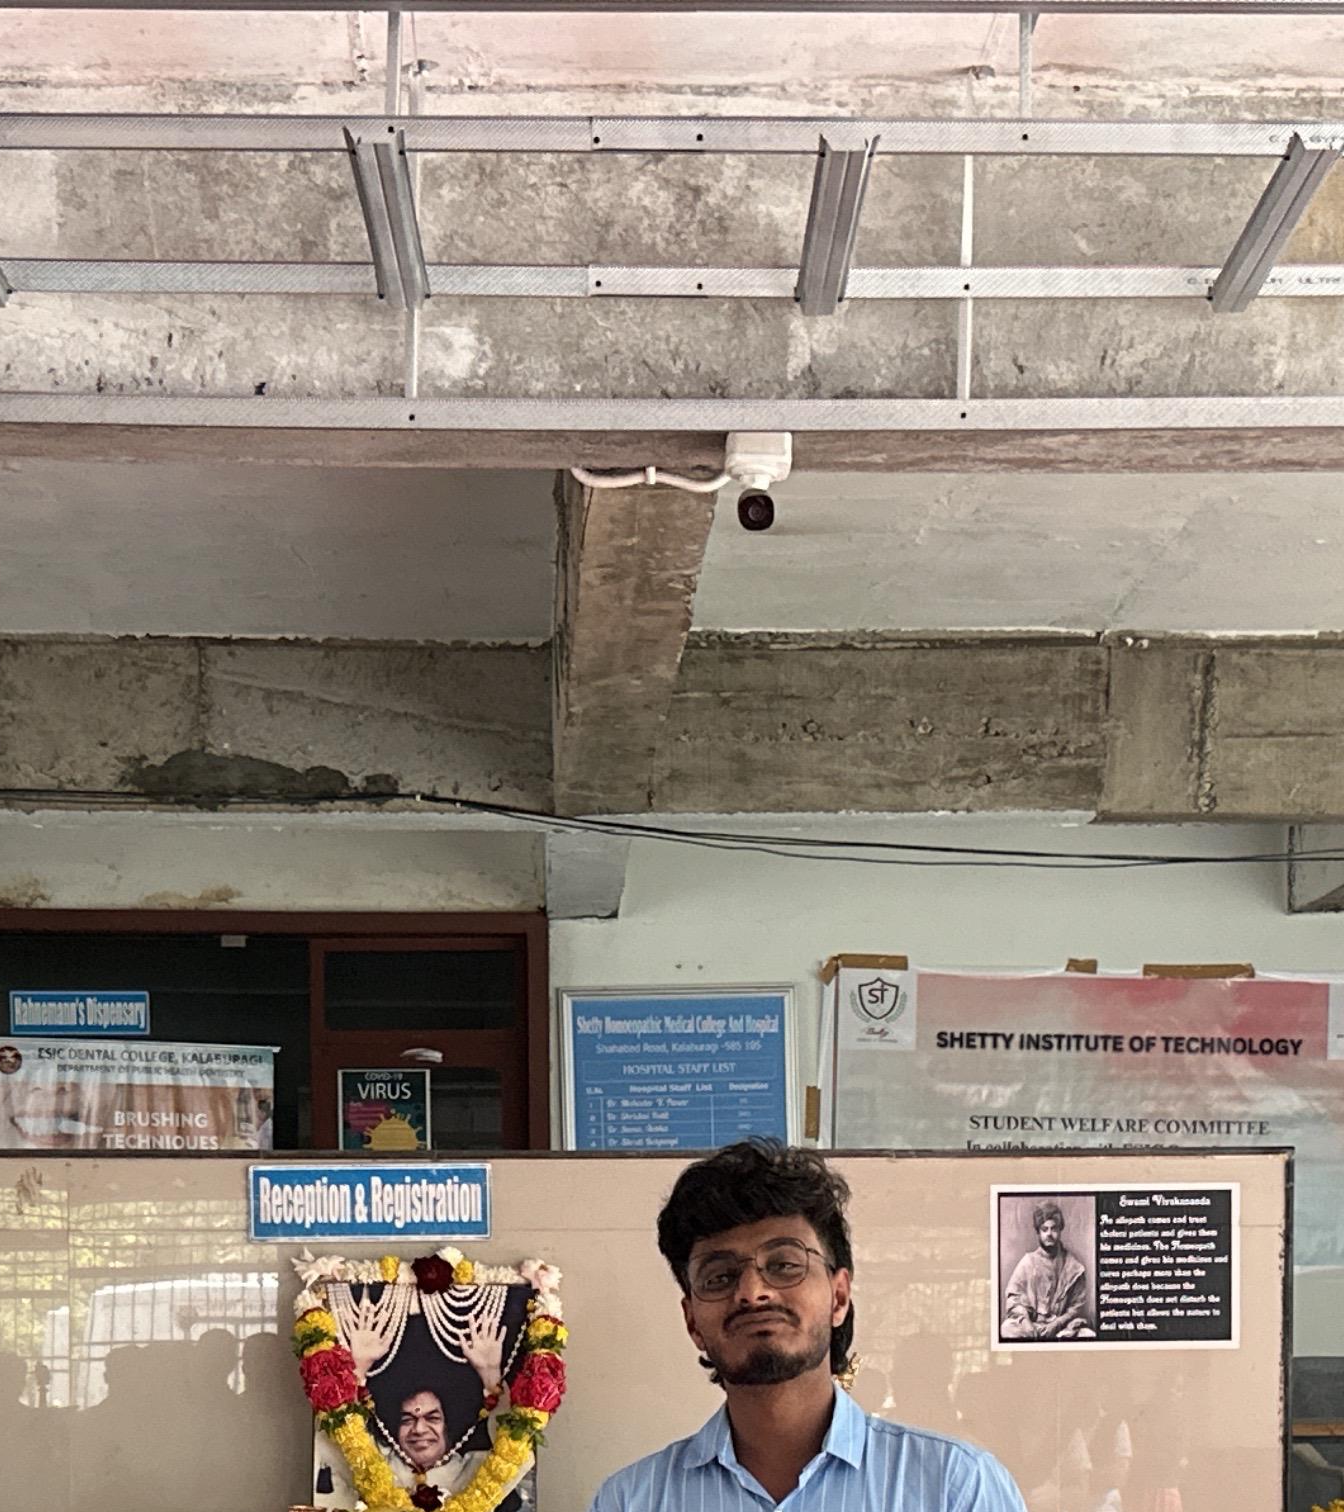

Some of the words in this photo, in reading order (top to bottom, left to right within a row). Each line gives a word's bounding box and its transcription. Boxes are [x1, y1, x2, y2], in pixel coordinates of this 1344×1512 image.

[86, 997, 146, 1029] Dispensary
[577, 1015, 603, 1038] Shetty
[664, 1014, 694, 1033] Medical
[696, 1014, 726, 1038] College
[729, 1015, 744, 1033] And
[745, 1014, 779, 1038] Hospital
[936, 1031, 1016, 1050] SHETTY
[1019, 1033, 1123, 1052] INSTITUTE
[1129, 1036, 1157, 1053] OF
[1160, 1036, 1303, 1056] TECHNOLOGY
[38, 1047, 65, 1060] ESIC
[68, 1048, 116, 1061] DENTAL
[120, 1050, 179, 1065] COLLEGE,
[365, 1071, 404, 1081] COVID-19
[623, 1064, 675, 1075] HOSPITAL
[677, 1063, 709, 1074] STAFF
[713, 1062, 737, 1073] LIST
[357, 1082, 412, 1100] VIRUS
[114, 1111, 208, 1129] BRUSHING
[969, 1114, 1056, 1131] STUDENT
[1060, 1116, 1150, 1133] WELFARE
[1154, 1118, 1272, 1136] COMMITTEE
[103, 1134, 219, 1150] TECHNIQUES
[259, 1176, 351, 1229] Reception
[355, 1182, 368, 1224] &
[370, 1175, 483, 1229] Registration
[1119, 1194, 1150, 1207] Swami
